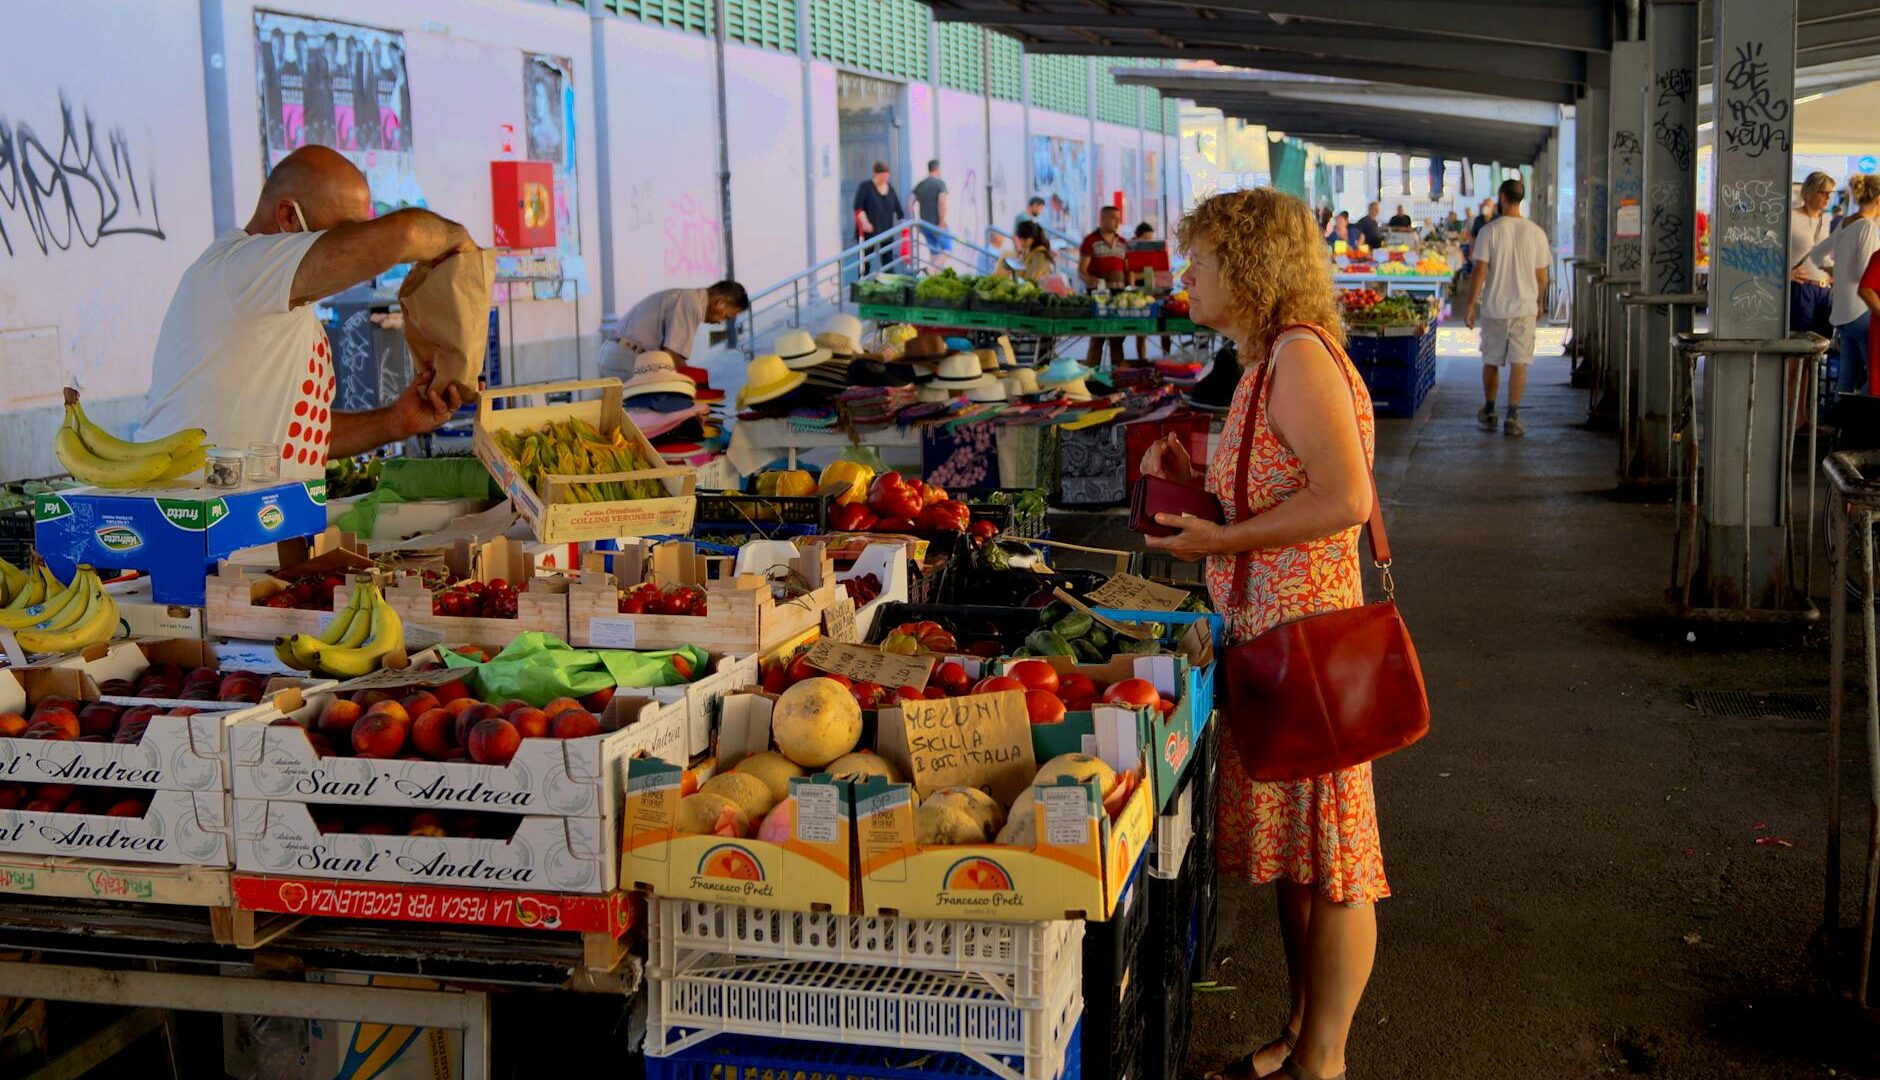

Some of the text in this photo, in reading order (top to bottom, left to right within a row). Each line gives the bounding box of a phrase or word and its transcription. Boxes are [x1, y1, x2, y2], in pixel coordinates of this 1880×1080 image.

[43, 502, 61, 514] Val
[166, 507, 199, 521] frutta
[570, 515, 609, 525] COLLINE
[104, 534, 138, 546] Valfrutta
[962, 744, 1021, 765] ITALIA
[36, 754, 165, 784] Andrea
[394, 775, 536, 806] Andrea
[39, 822, 168, 851] Andrea
[395, 851, 537, 883] Andrea
[689, 875, 741, 893] Francesco
[743, 881, 775, 897] Preti
[311, 888, 513, 924] LA PESCA PER ECCELLENZA
[935, 892, 1024, 907] Francesco Preti
